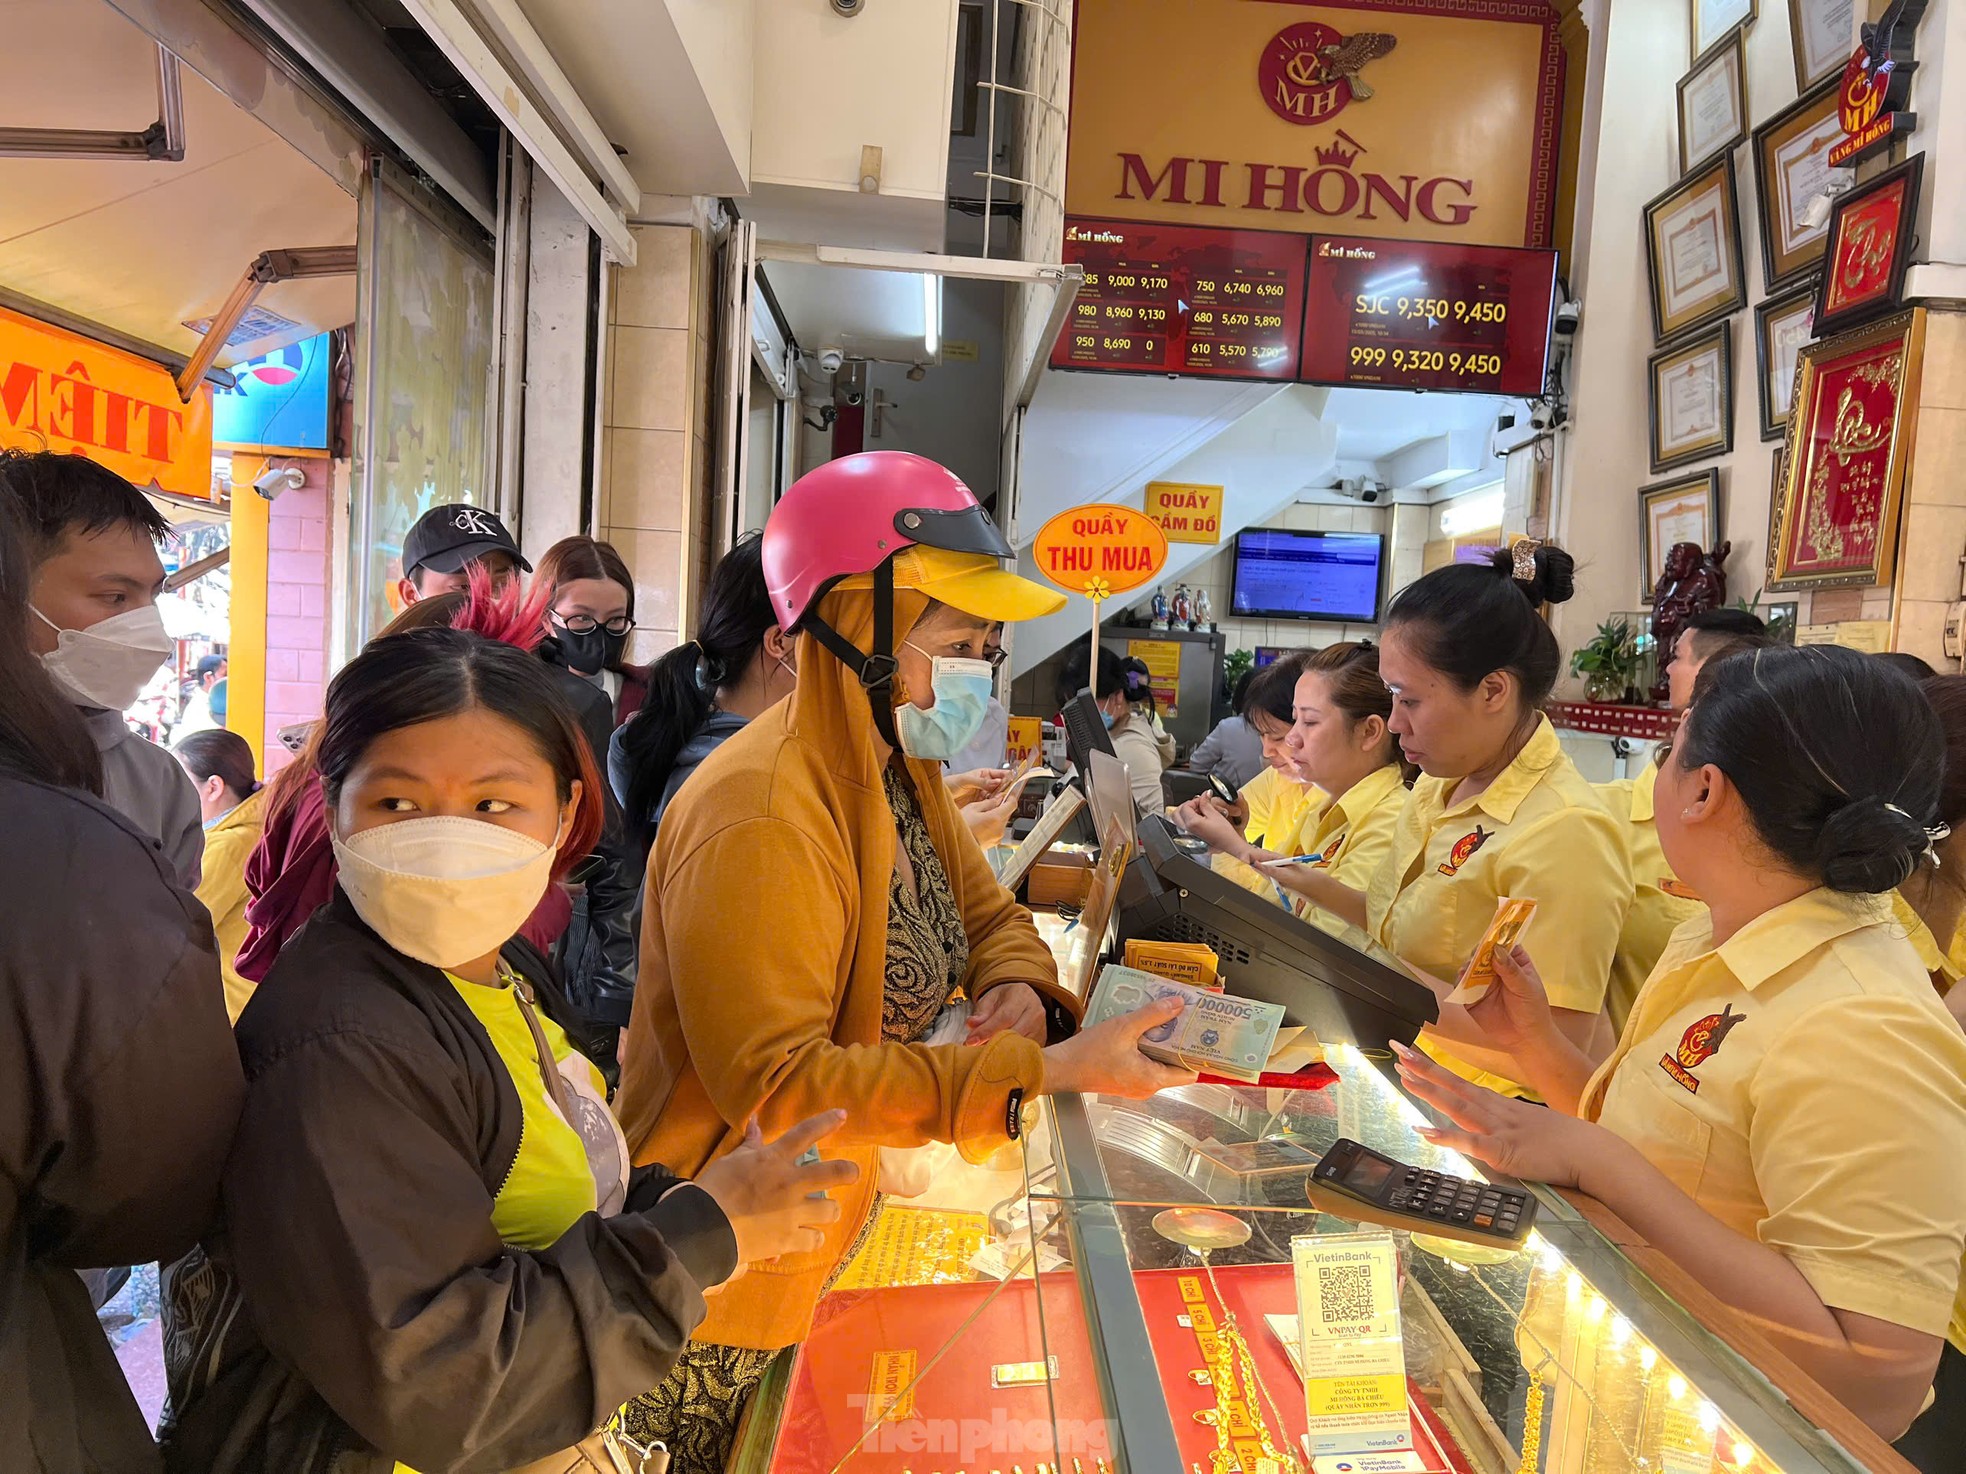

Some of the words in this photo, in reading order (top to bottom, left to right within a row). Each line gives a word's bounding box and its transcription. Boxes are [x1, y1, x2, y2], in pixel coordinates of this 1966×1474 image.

[1275, 75, 1340, 117] MH
[1844, 86, 1880, 133] MH
[1114, 153, 1230, 207] MI
[1108, 275, 1135, 288] 9,000
[1140, 277, 1168, 290] 9,170
[1196, 280, 1215, 292] 750
[1223, 282, 1251, 295] 6,740
[1256, 284, 1284, 297] 6,960
[1077, 304, 1097, 316] 980
[1105, 306, 1133, 319] 8,960
[1138, 308, 1166, 321] 9,130
[1193, 311, 1213, 323] 680
[1221, 313, 1249, 326] 5,670
[1254, 315, 1282, 328] 5,890
[1355, 294, 1390, 315] SJC
[1397, 297, 1449, 320] 9,350
[1454, 301, 1506, 324] 9,450
[1075, 336, 1095, 347] 950
[1103, 338, 1131, 350] 8,690
[1146, 340, 1154, 351] 0
[1191, 343, 1211, 354] 610
[1219, 344, 1247, 357] 5,570
[1252, 347, 1279, 358] 5,790
[1350, 346, 1387, 367] 999
[1392, 349, 1444, 372] 9,320
[1449, 353, 1501, 376] 9,450
[1072, 512, 1129, 538] QUẦY
[1047, 546, 1093, 571] THU
[1102, 546, 1153, 571] MUA
[1314, 1251, 1372, 1263] VietinBank
